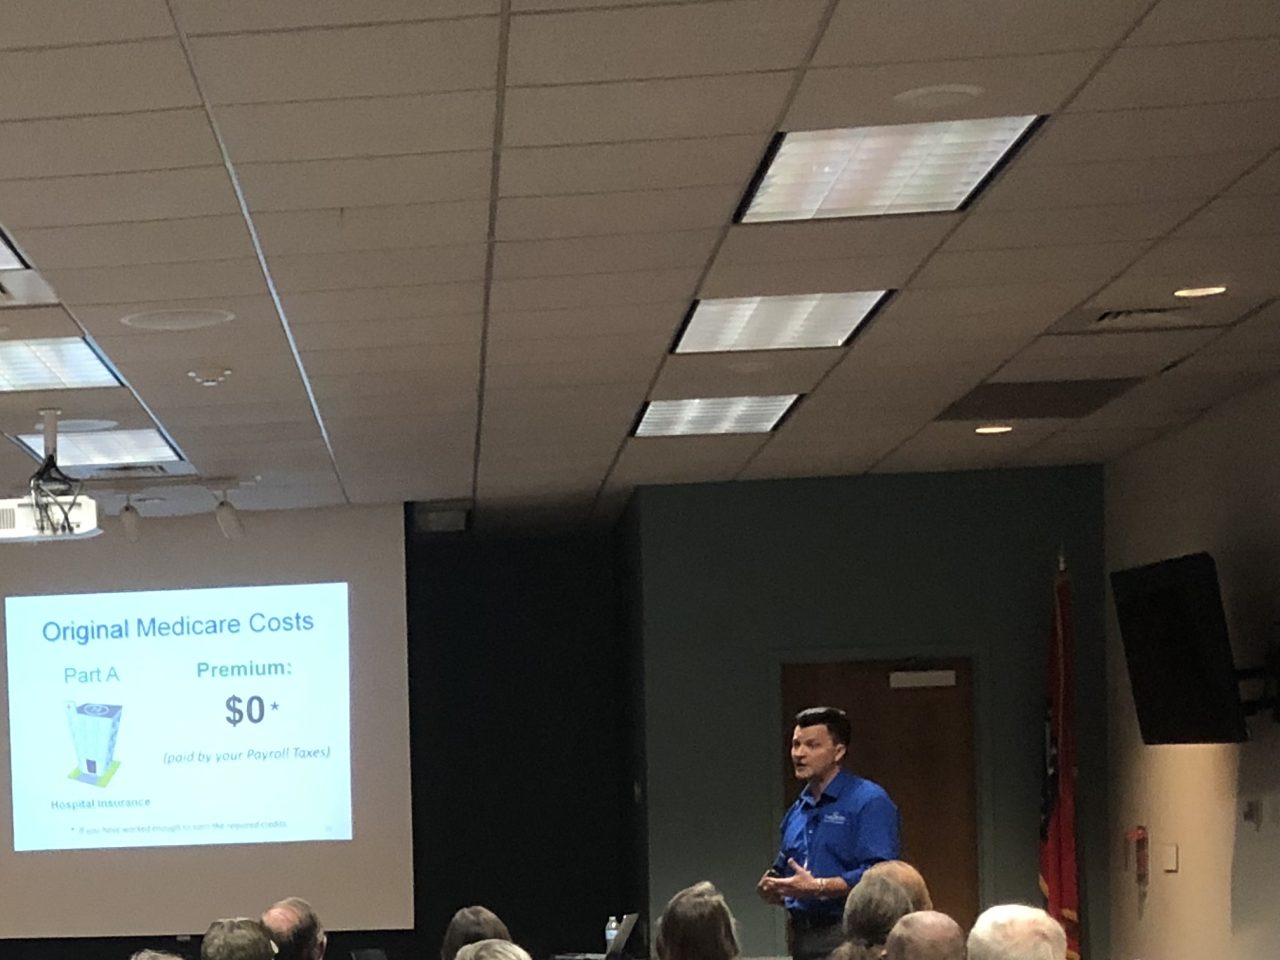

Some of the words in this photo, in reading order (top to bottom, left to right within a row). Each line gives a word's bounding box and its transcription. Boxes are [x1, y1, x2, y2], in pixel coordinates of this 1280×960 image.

[42, 619, 129, 645] Original
[137, 616, 241, 637] Medicare
[249, 612, 314, 633] Costs
[64, 667, 102, 684] Part
[106, 666, 120, 683] A
[197, 660, 292, 678] Premium:
[163, 751, 195, 765] (paid
[197, 751, 211, 763] by
[215, 751, 244, 763] your
[247, 748, 290, 761] Payroll
[293, 746, 332, 759] Taxes)
[51, 799, 95, 811] Hospital
